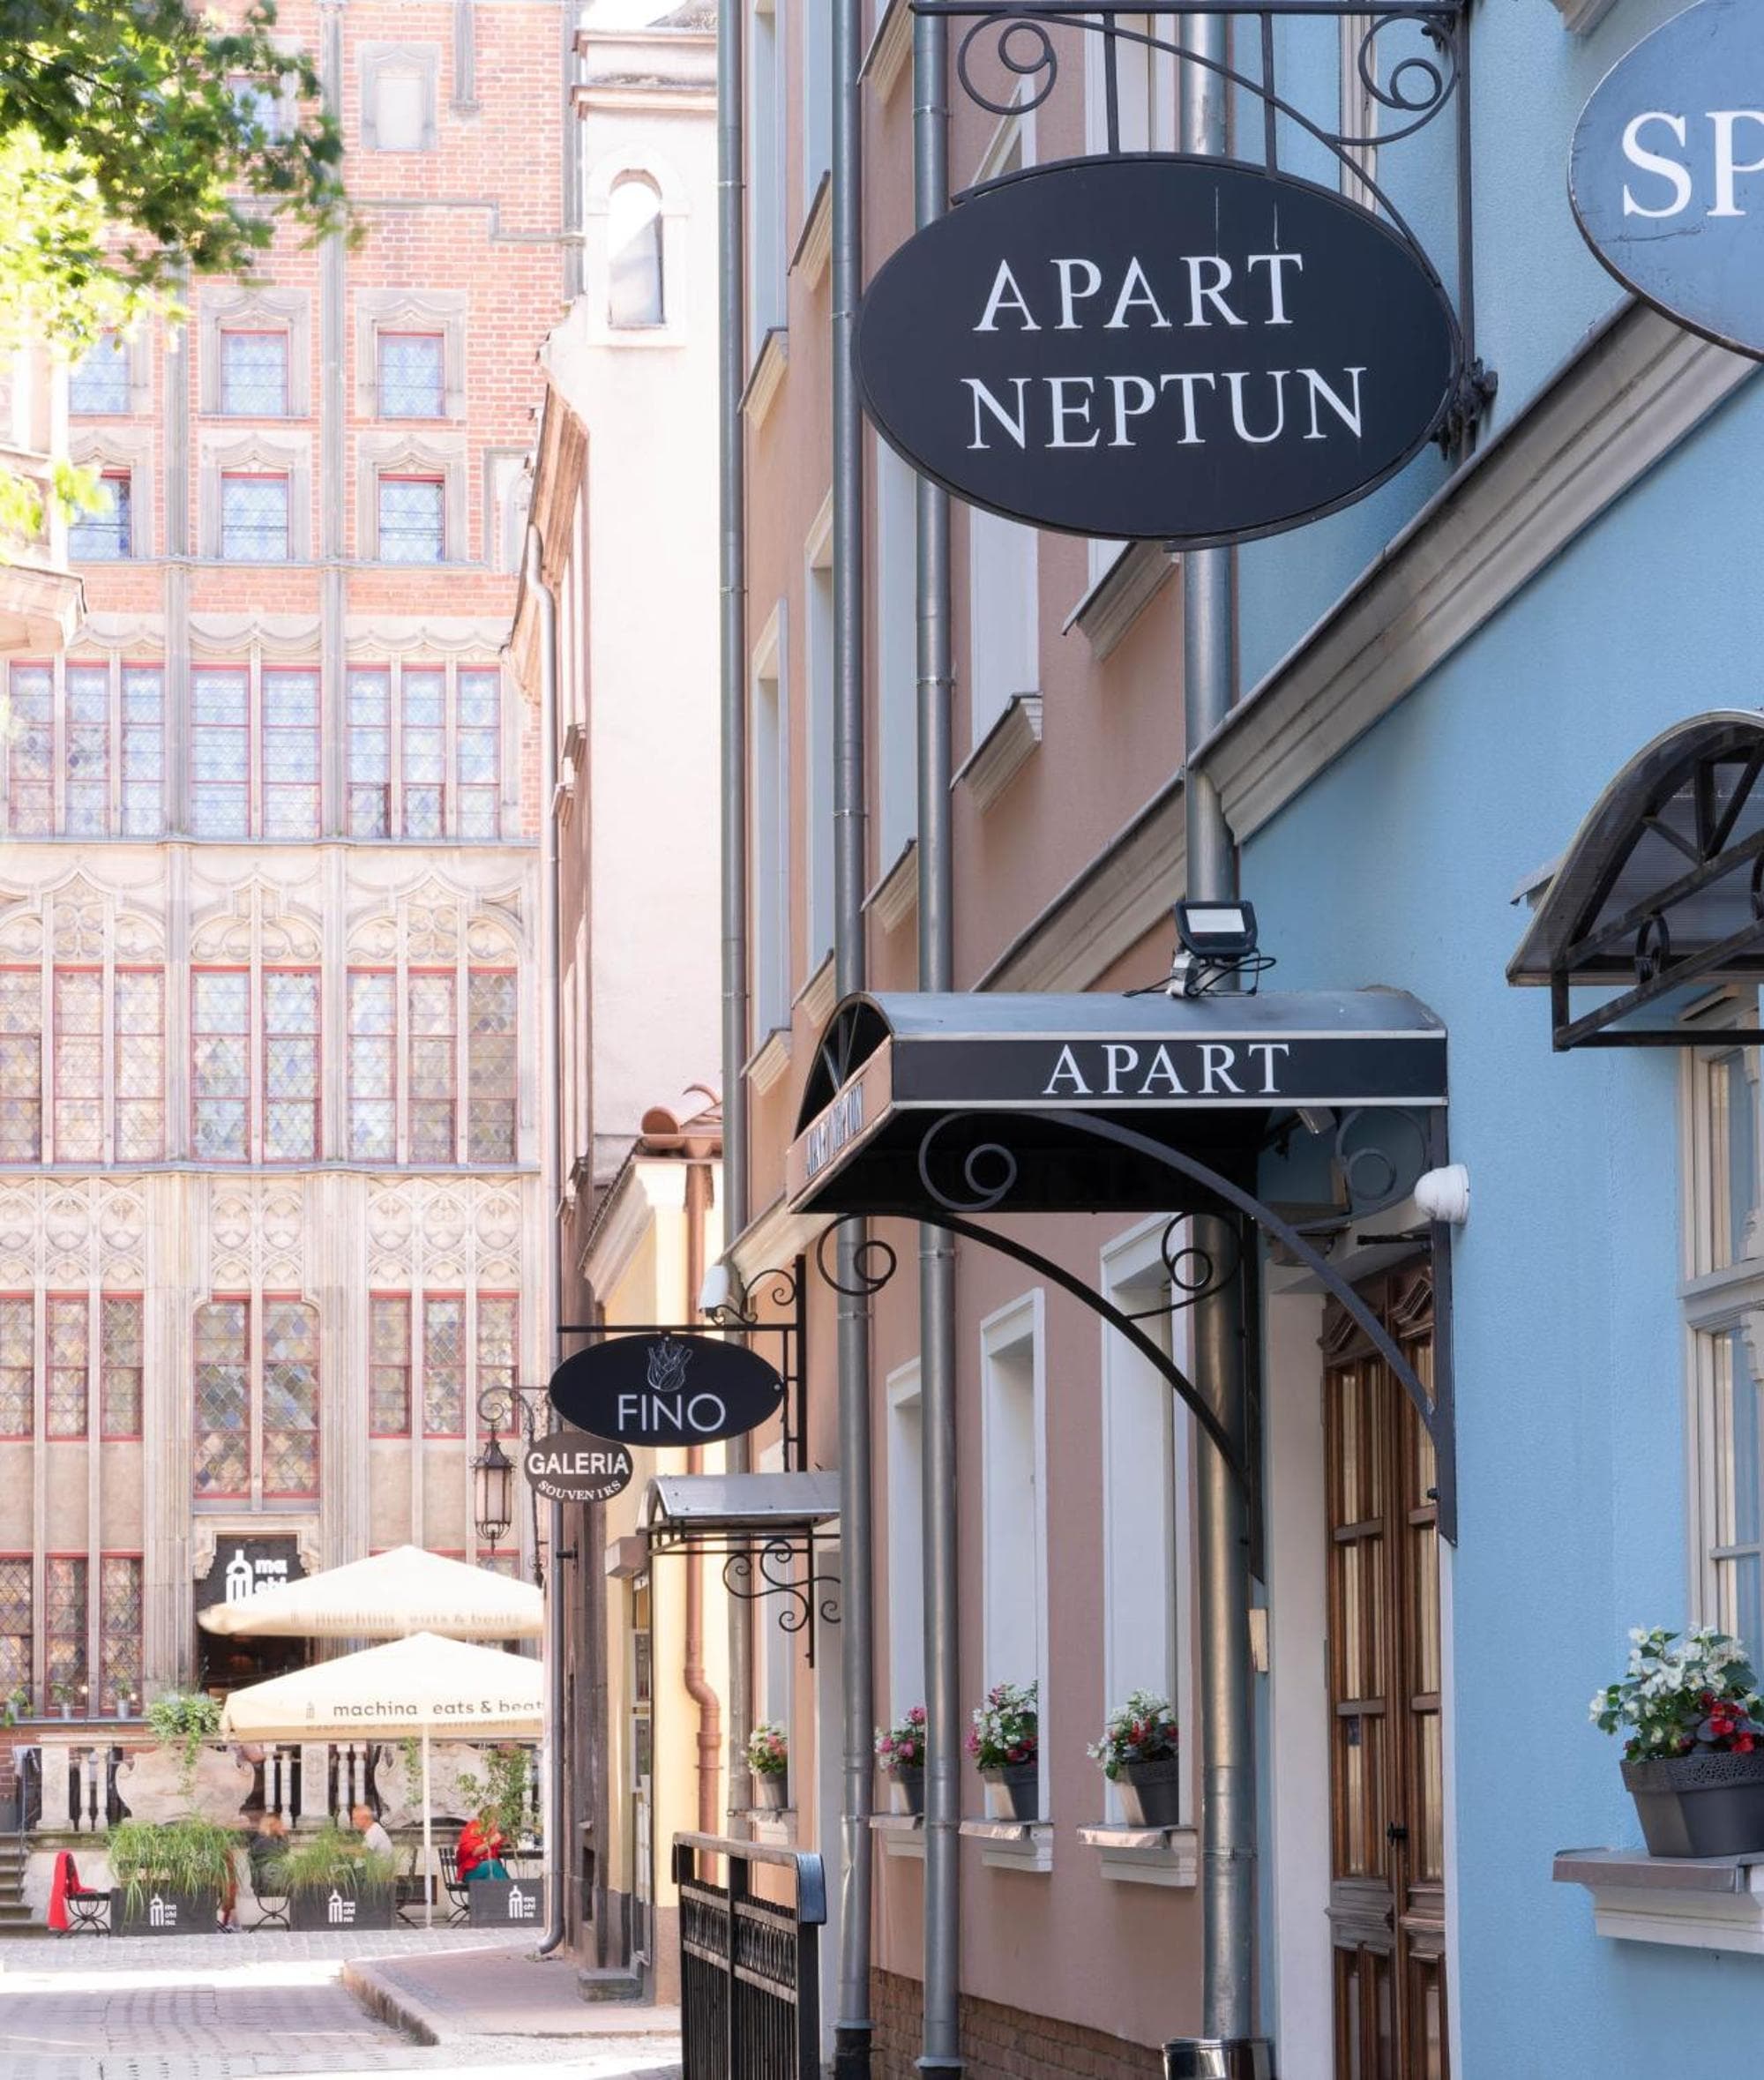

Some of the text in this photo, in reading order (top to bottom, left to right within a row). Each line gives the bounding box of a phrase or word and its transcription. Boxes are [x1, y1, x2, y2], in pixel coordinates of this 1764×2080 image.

[971, 252, 1304, 332] APART
[960, 366, 1367, 451] NEPTUN
[1042, 1043, 1291, 1096] APART
[617, 1392, 727, 1433] FINO
[527, 1452, 630, 1475] GALERIA
[333, 1699, 544, 1717] machina eats & beat
